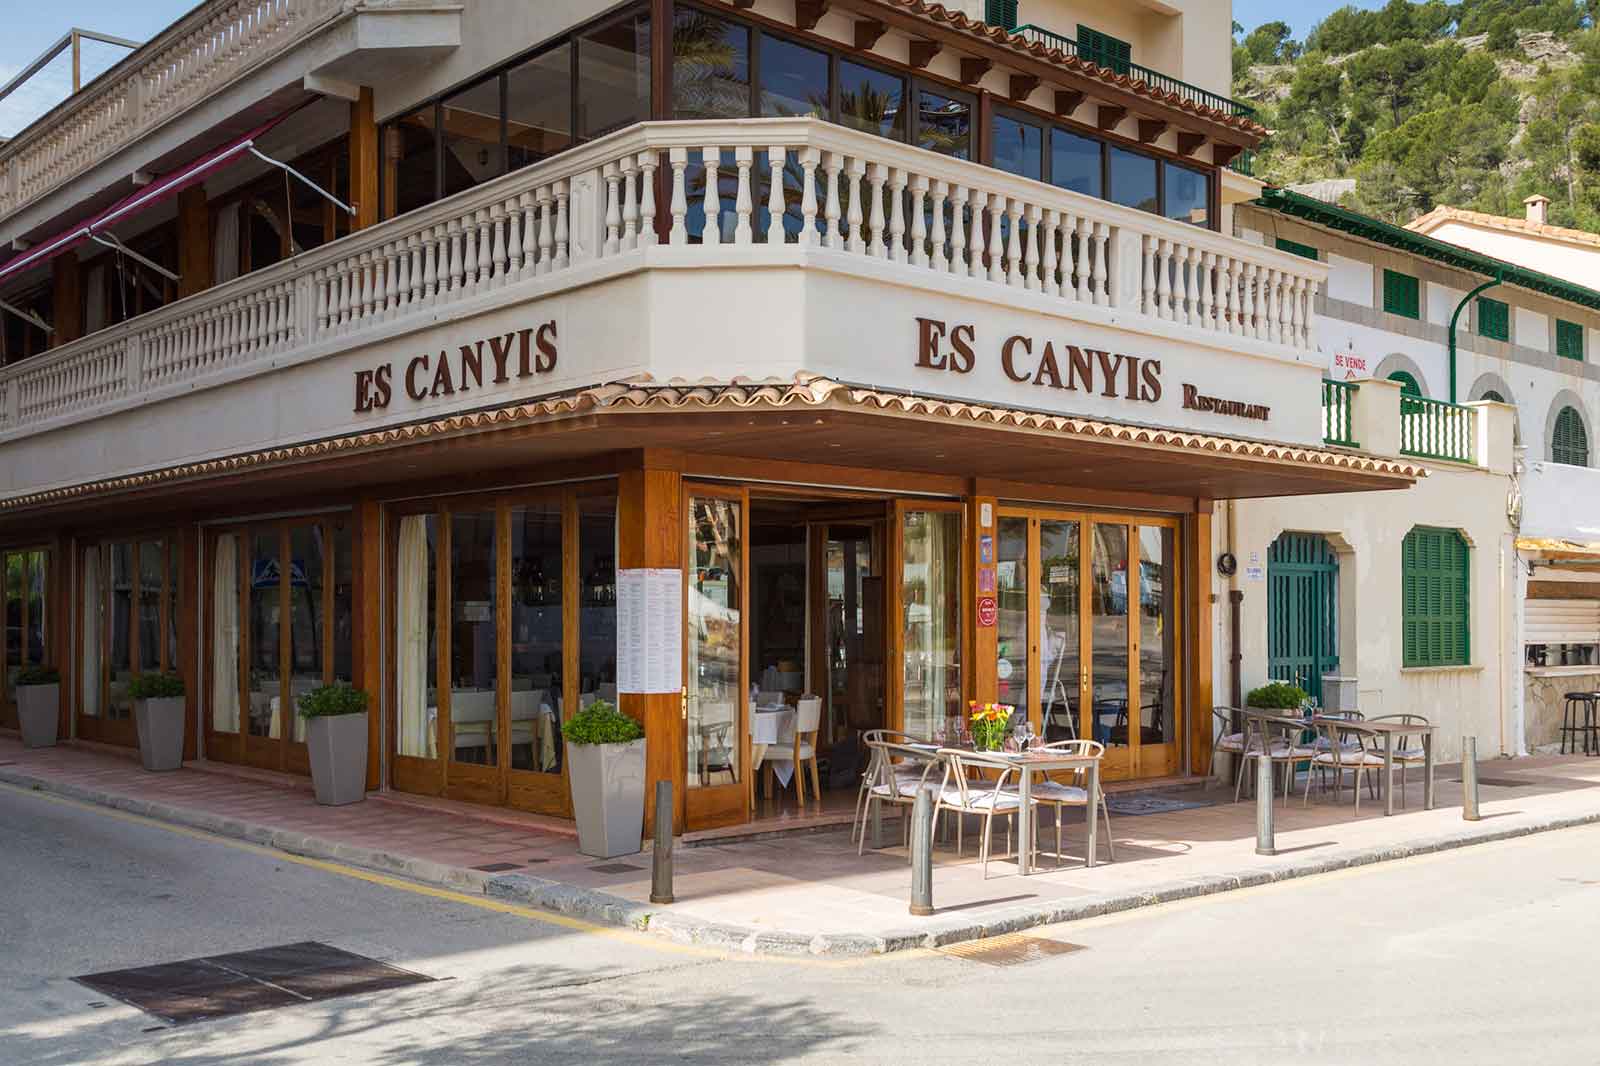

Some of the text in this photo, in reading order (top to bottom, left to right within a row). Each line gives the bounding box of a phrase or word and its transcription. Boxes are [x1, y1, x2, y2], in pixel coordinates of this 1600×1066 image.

[354, 320, 558, 413] ES CANYIS
[914, 317, 1162, 403] ES CANYIS
[1335, 354, 1366, 371] SE VENDE
